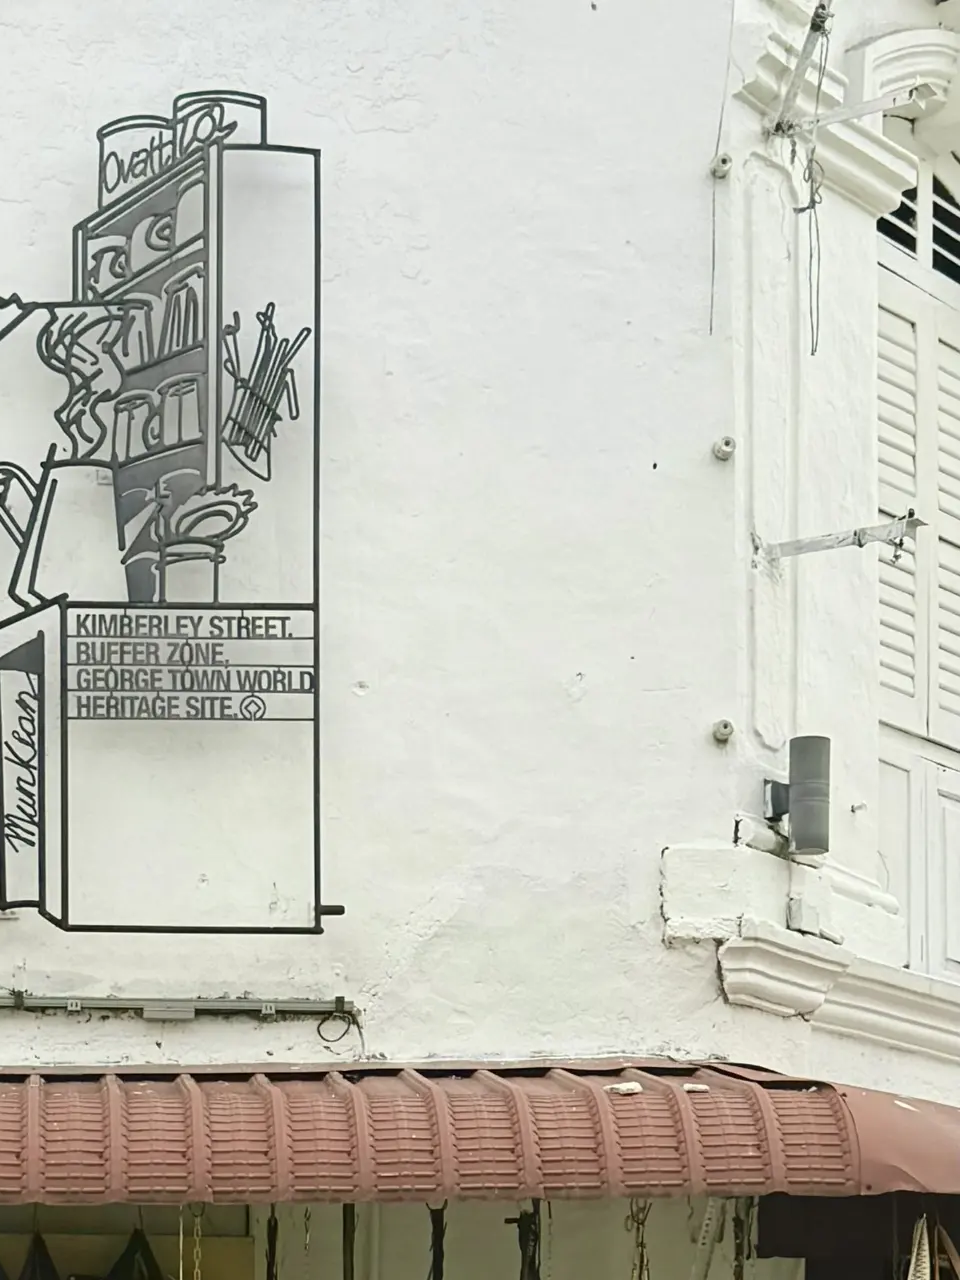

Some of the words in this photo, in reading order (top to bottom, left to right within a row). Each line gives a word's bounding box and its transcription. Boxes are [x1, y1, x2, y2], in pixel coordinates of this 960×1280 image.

[76, 614, 202, 637] KIMBERLEY
[209, 616, 292, 638] STREET.
[76, 642, 159, 664] BUFFER
[167, 643, 230, 669] ZONE,
[76, 668, 163, 691] GEORGE
[168, 669, 230, 692] TOWN
[237, 670, 314, 693] WORLD
[76, 696, 179, 718] HERITAGE
[186, 697, 238, 719] SITE.
